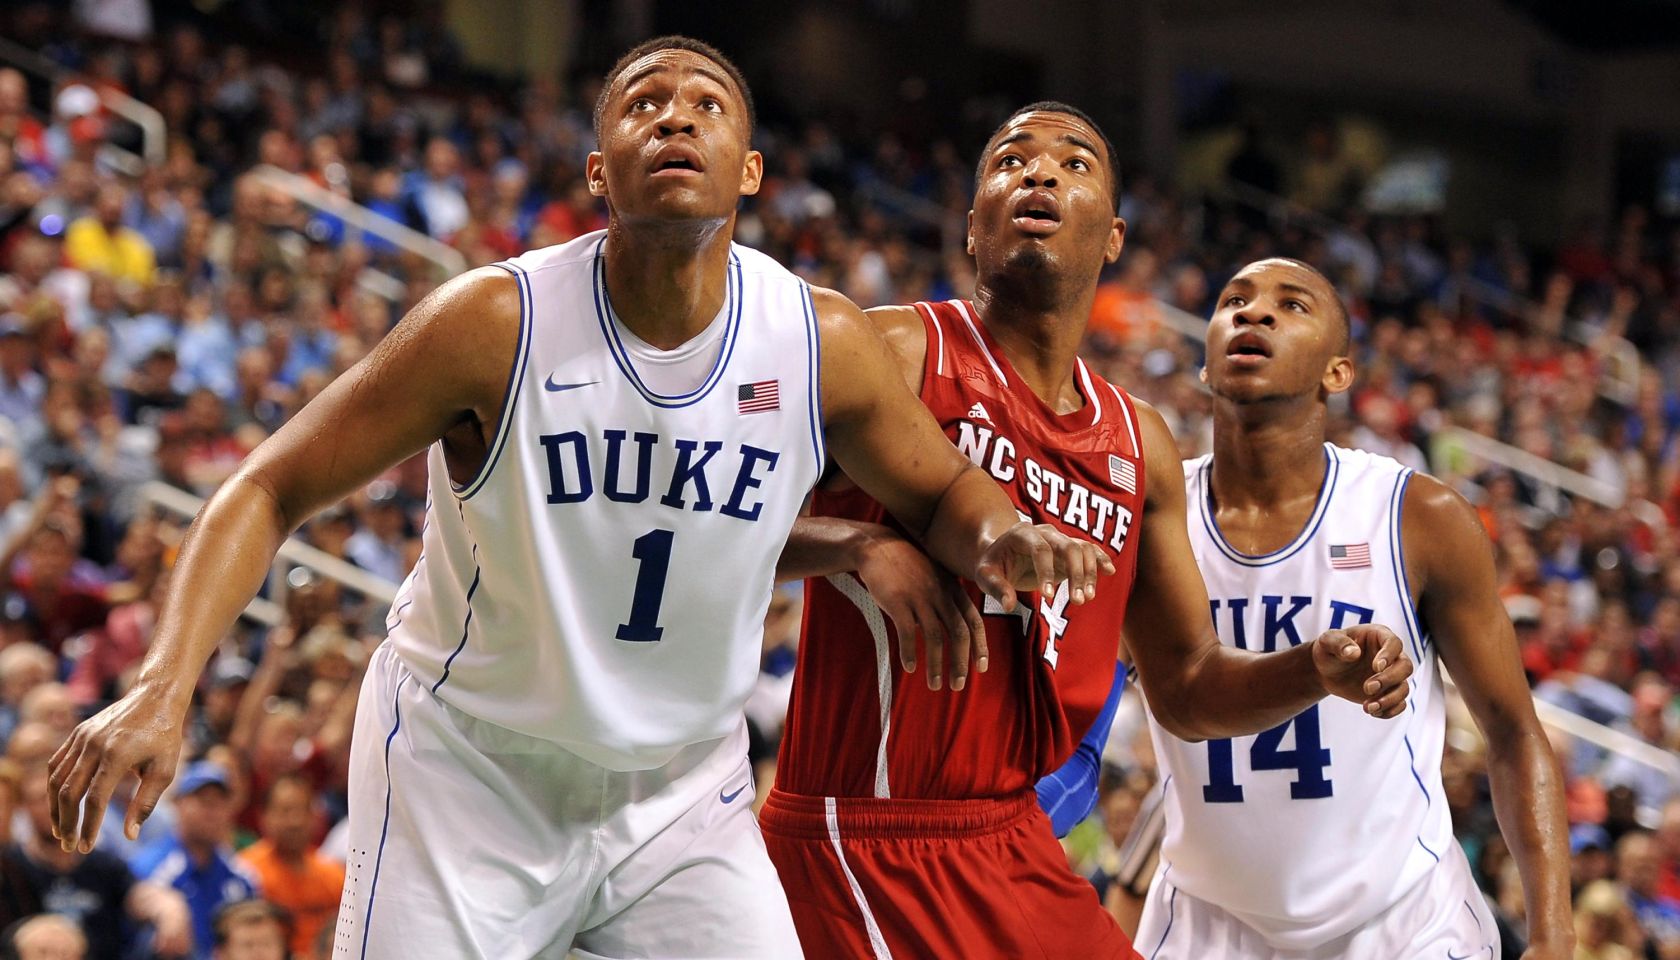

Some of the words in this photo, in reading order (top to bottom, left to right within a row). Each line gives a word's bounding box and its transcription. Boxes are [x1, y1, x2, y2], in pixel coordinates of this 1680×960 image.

[539, 429, 780, 522] DUKE
[957, 421, 1016, 482] NC
[1024, 457, 1133, 553] STATE
[615, 528, 674, 642] 1
[1209, 595, 1375, 652] UK
[1203, 703, 1334, 803] 14
